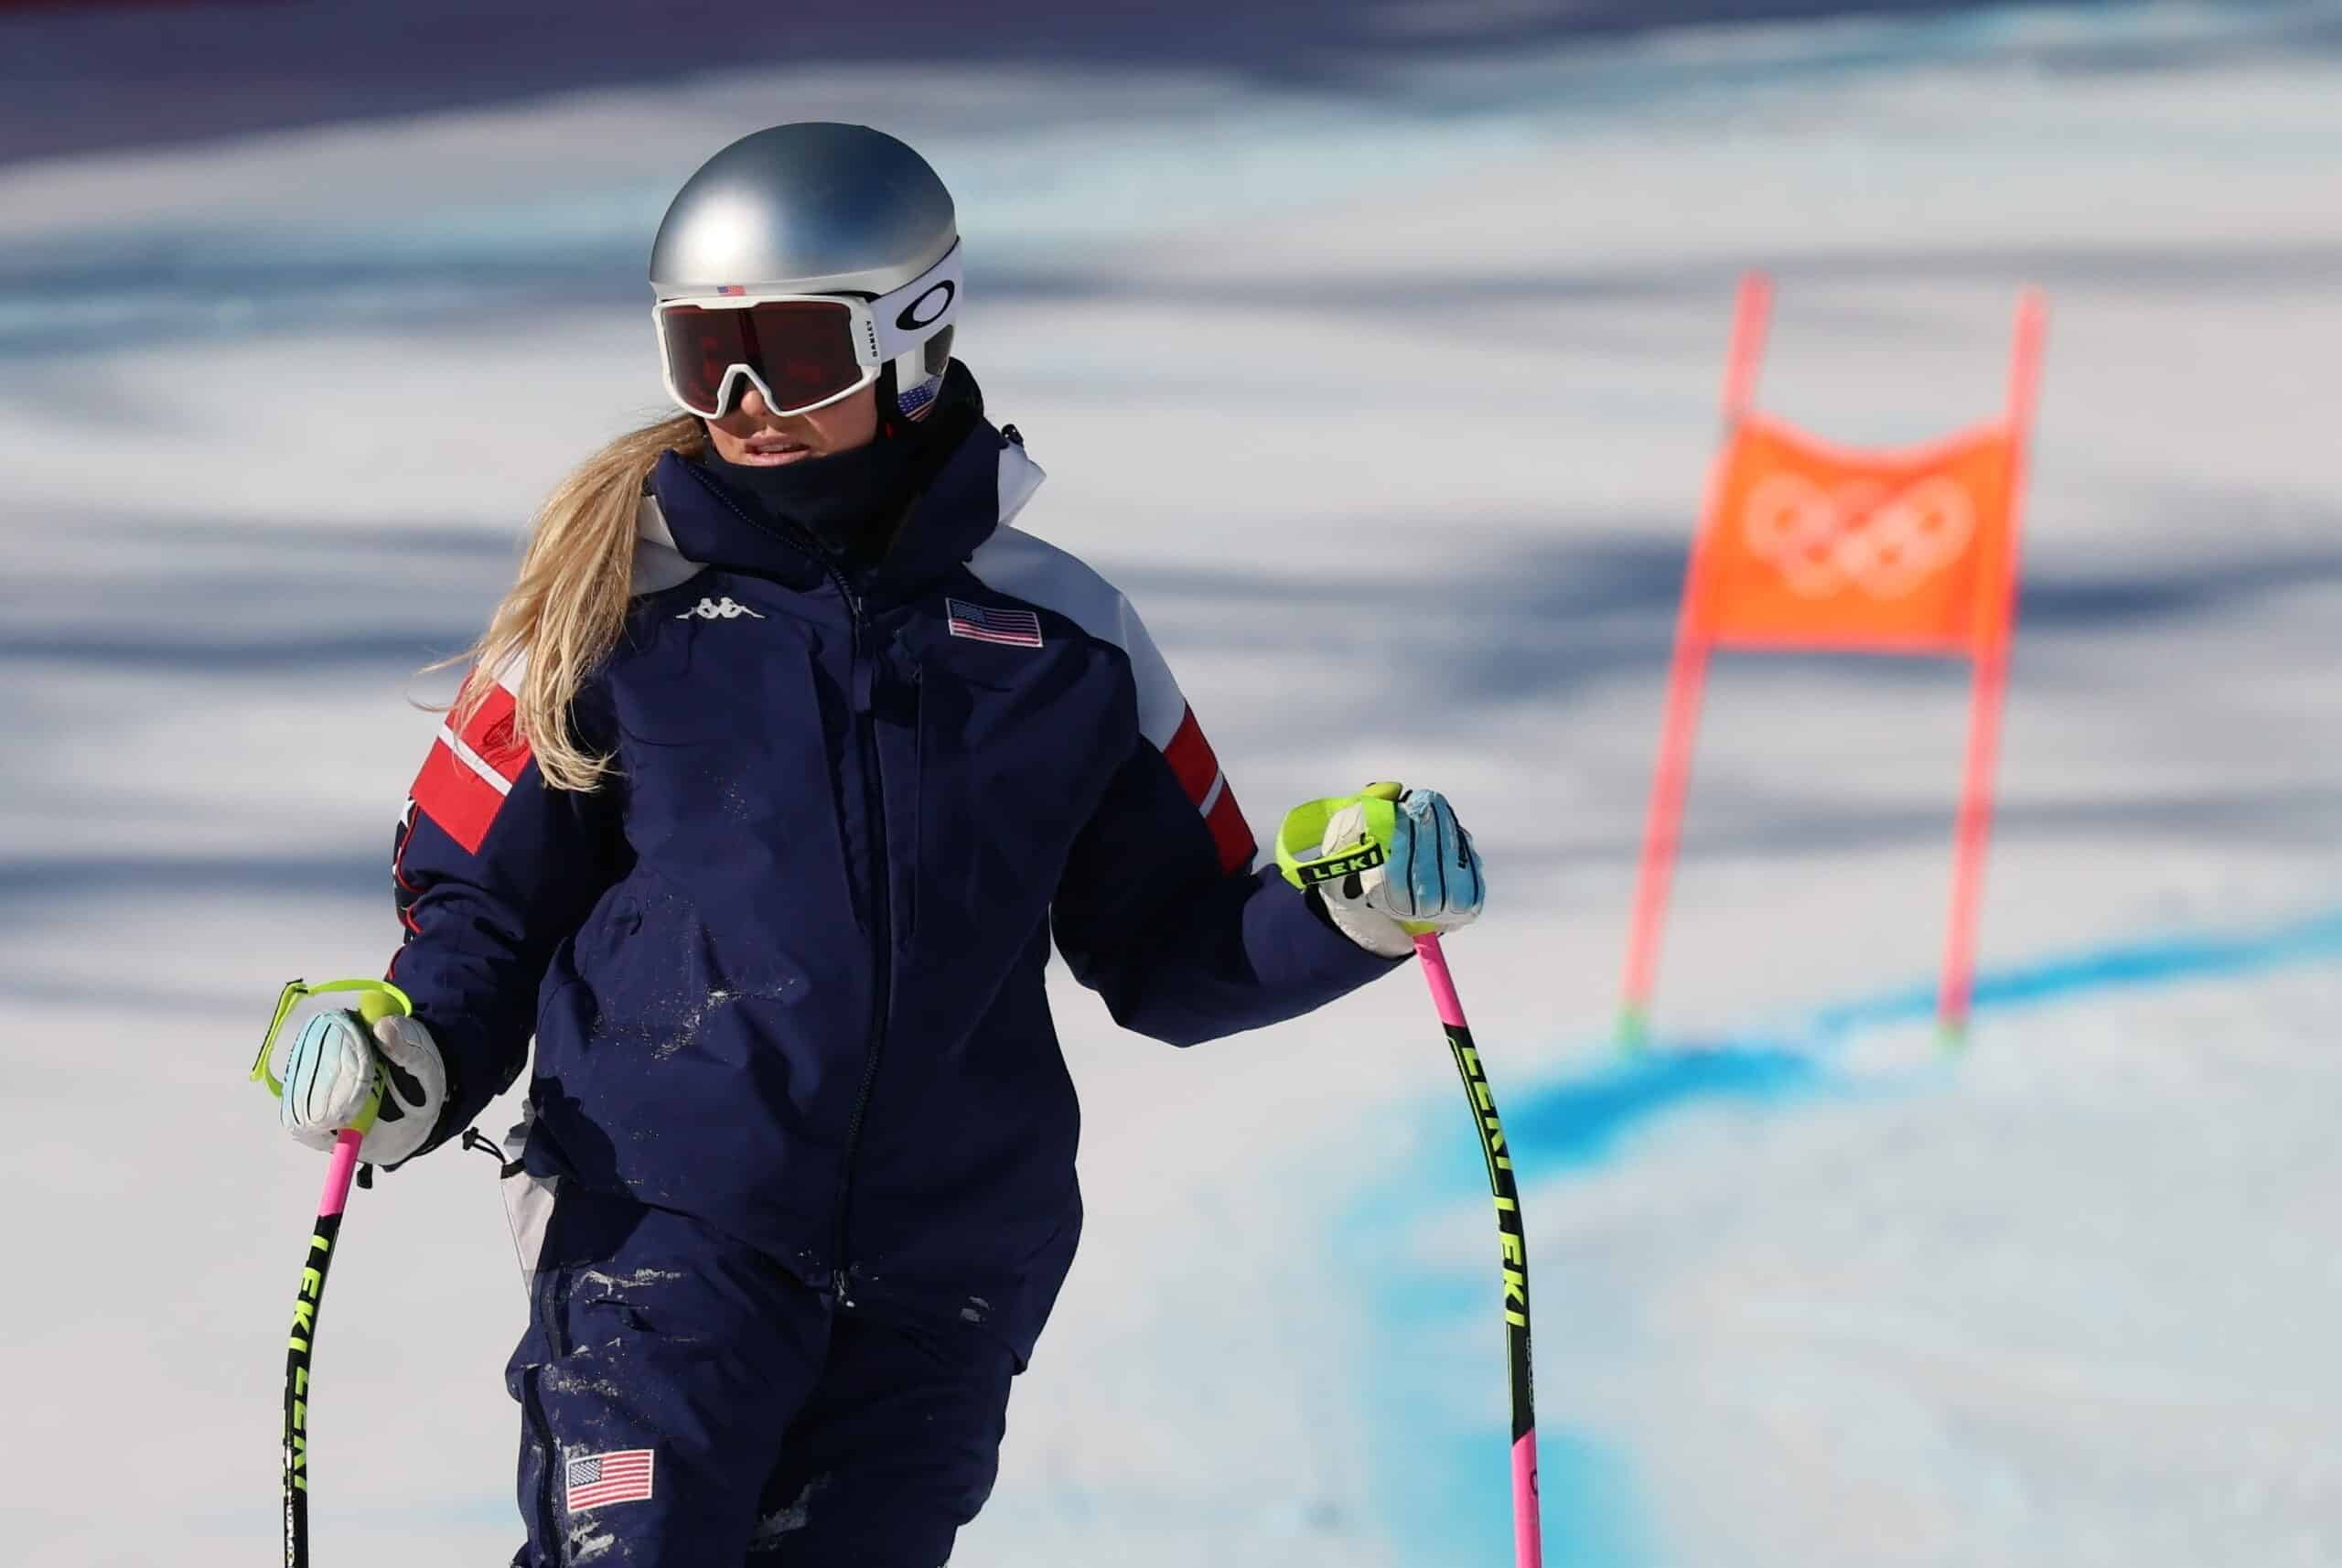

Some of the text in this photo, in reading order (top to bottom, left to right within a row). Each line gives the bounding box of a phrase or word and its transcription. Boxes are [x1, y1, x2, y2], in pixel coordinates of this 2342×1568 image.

[1313, 850, 1379, 879] LEKI
[289, 1235, 328, 1352] LEKI
[1494, 1195, 1526, 1326] LEKI
